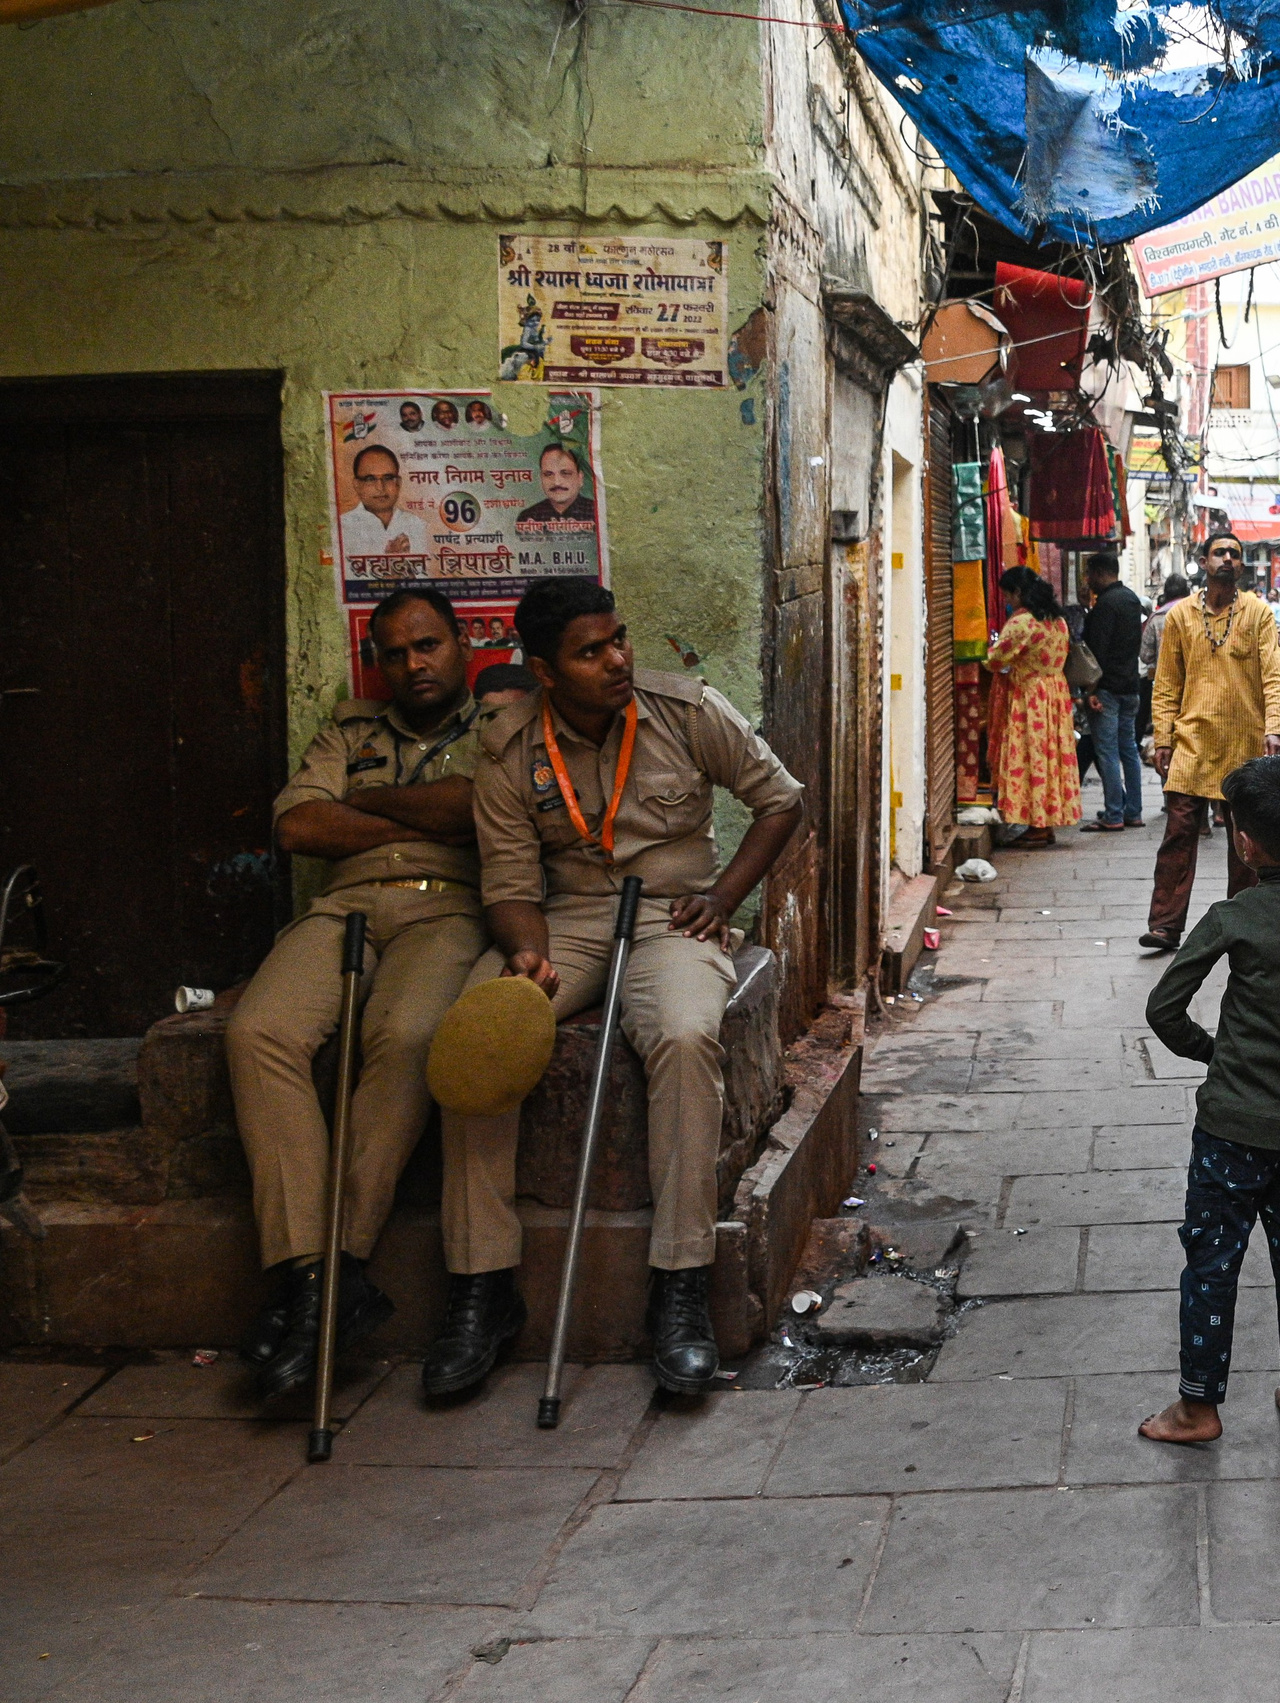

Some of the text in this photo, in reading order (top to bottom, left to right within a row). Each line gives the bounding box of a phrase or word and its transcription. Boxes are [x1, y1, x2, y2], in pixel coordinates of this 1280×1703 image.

[1264, 213, 1279, 229] की
[548, 244, 560, 253] 28
[507, 264, 715, 292] श्री श्याम ध्वजा शोभायात्रा
[656, 303, 681, 322] 27
[682, 302, 715, 313] फरवरी
[409, 465, 533, 489] नगर निगम चुनाव
[444, 499, 476, 524] 96
[465, 533, 504, 545] प्रत्याशी
[348, 545, 514, 578] ब्रह्मदत्त त्रिपाठी
[519, 552, 589, 564] M.A. B.H.U.
